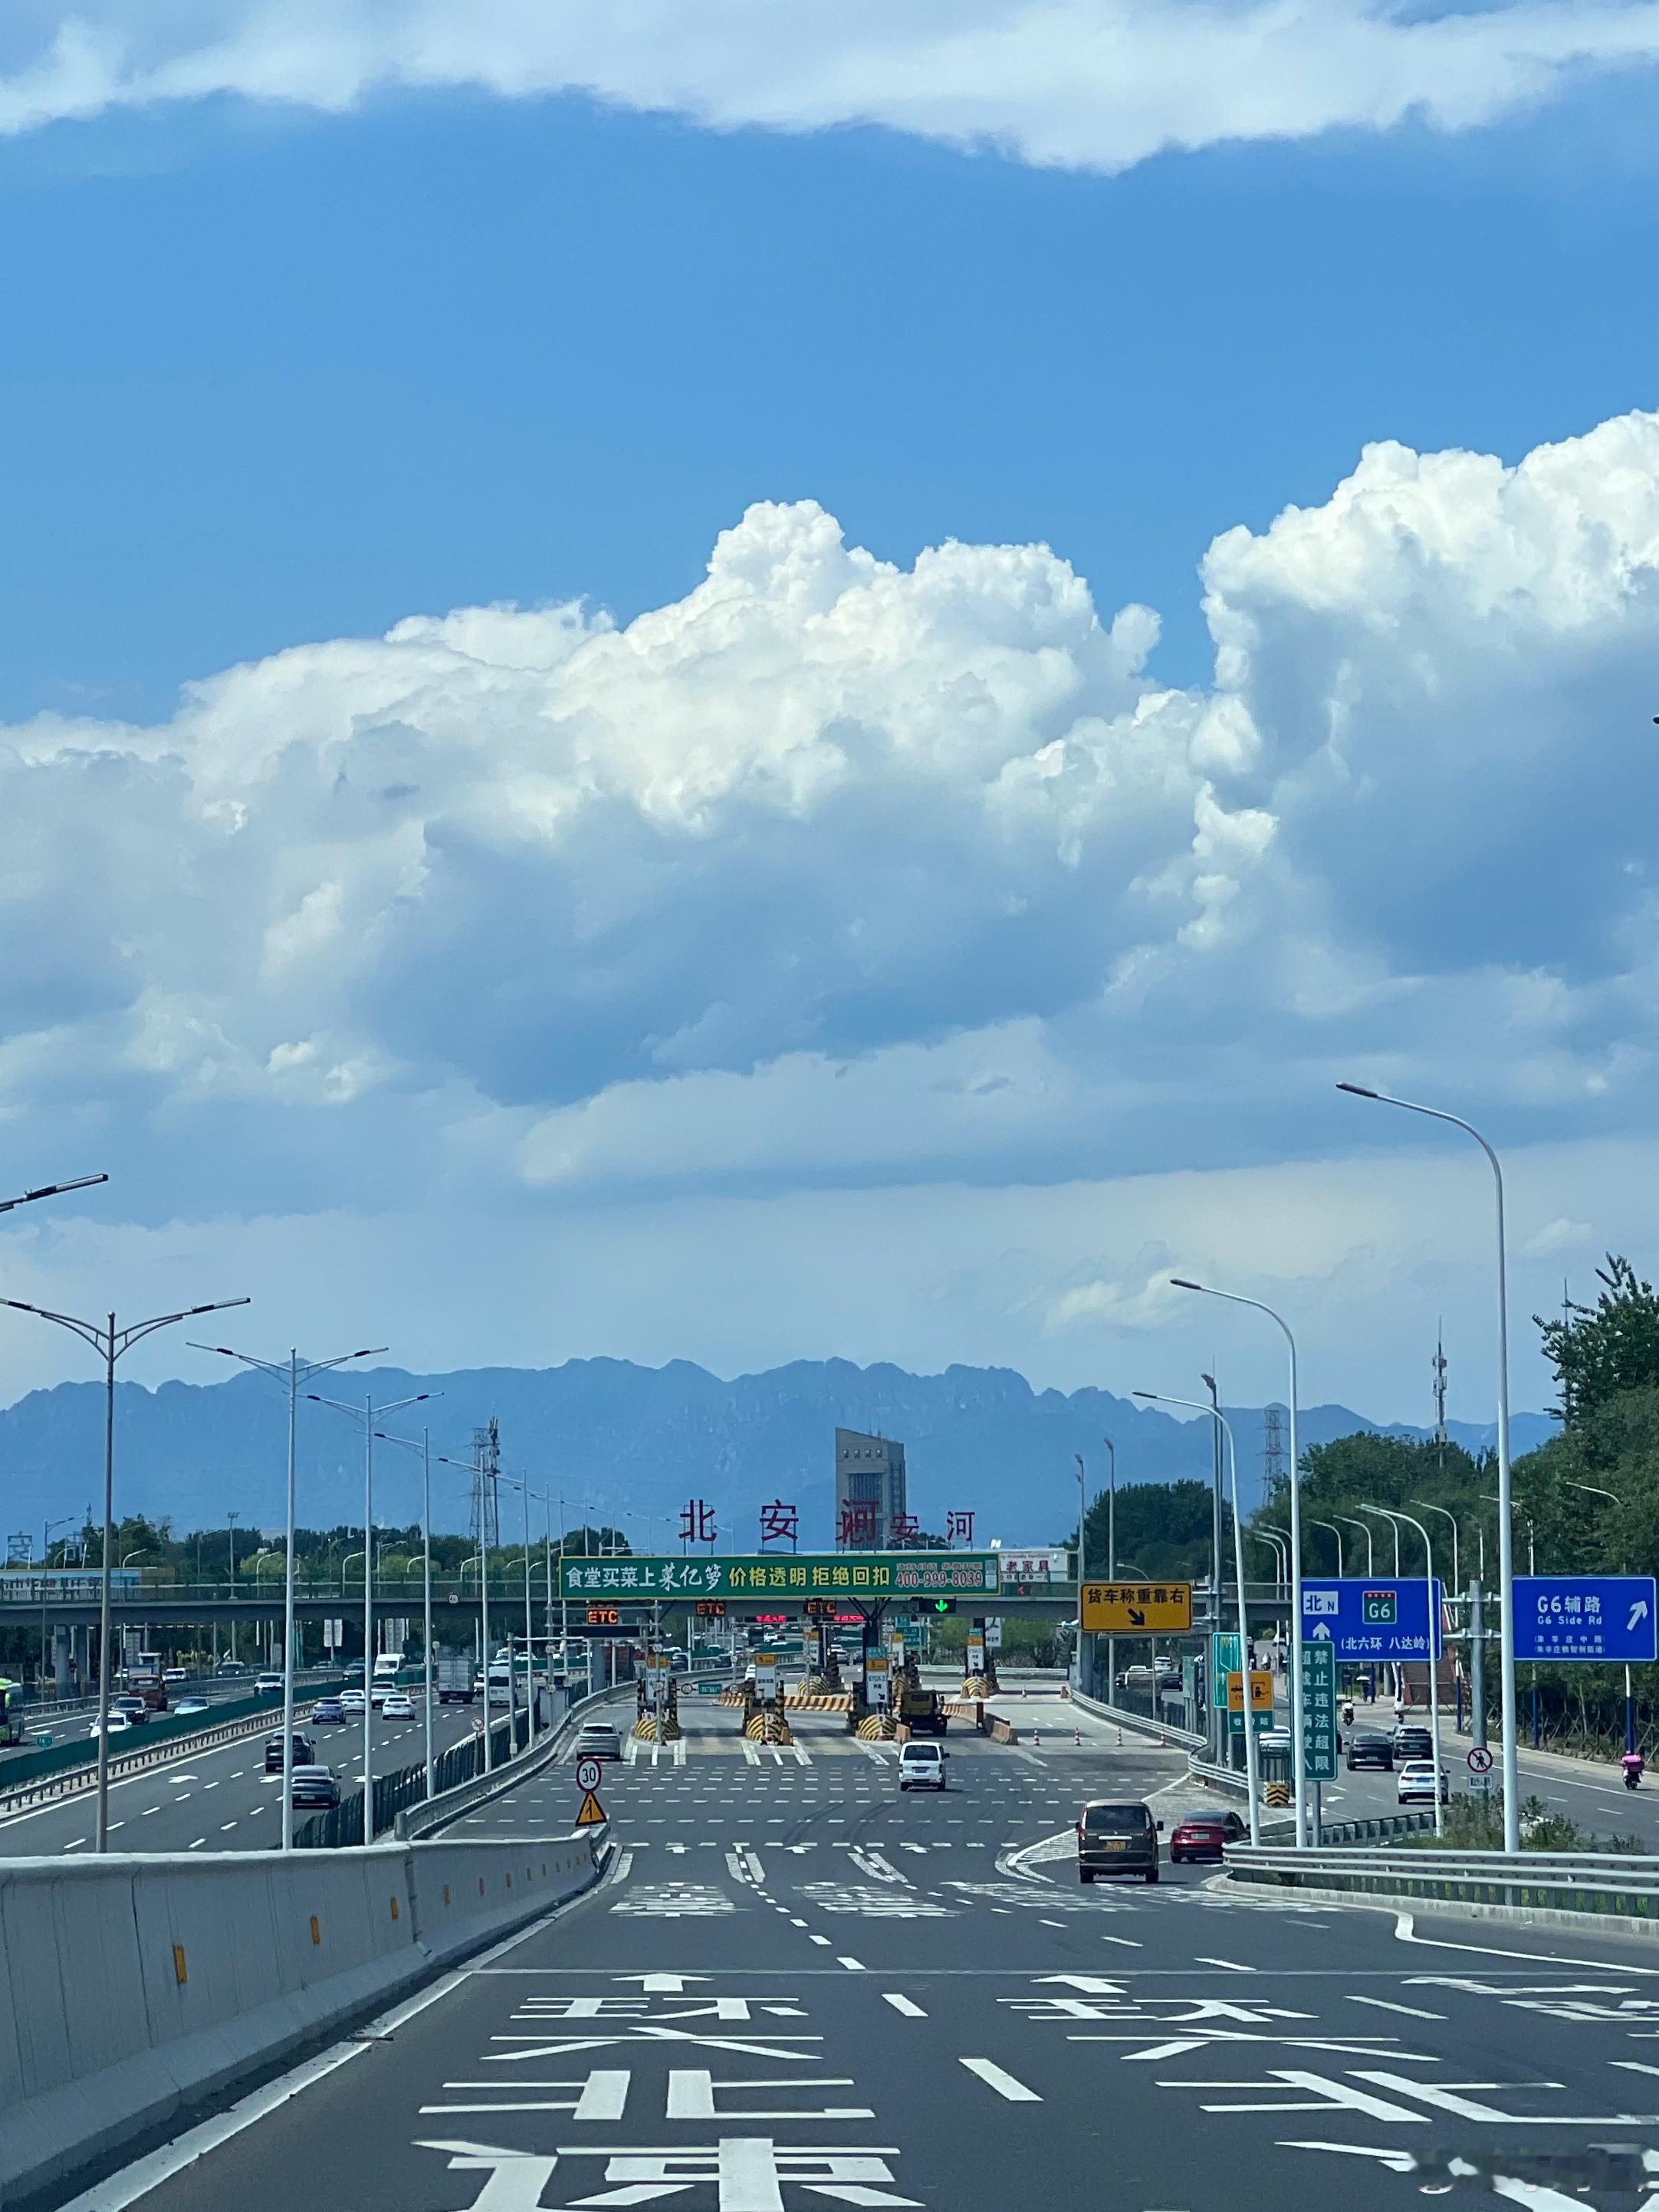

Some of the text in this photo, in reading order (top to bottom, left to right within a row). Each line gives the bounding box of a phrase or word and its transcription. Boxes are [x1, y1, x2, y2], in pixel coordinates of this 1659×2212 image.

[729, 1566, 807, 1587] 价格透明
[812, 1566, 890, 1587] 拒绝回扣
[1087, 1588, 1185, 1605] 货车称重靠右
[1306, 1594, 1335, 1612] 北 N
[1537, 1595, 1601, 1613] G6辅路
[697, 1603, 724, 1615] ETC
[807, 1601, 836, 1613] ETC
[1369, 1602, 1391, 1619] G6
[588, 1610, 618, 1624] ETC
[1537, 1616, 1602, 1625] G6 Side Rd
[1314, 1649, 1329, 1771] 禁止违法超限
[582, 1767, 596, 1783] 30
